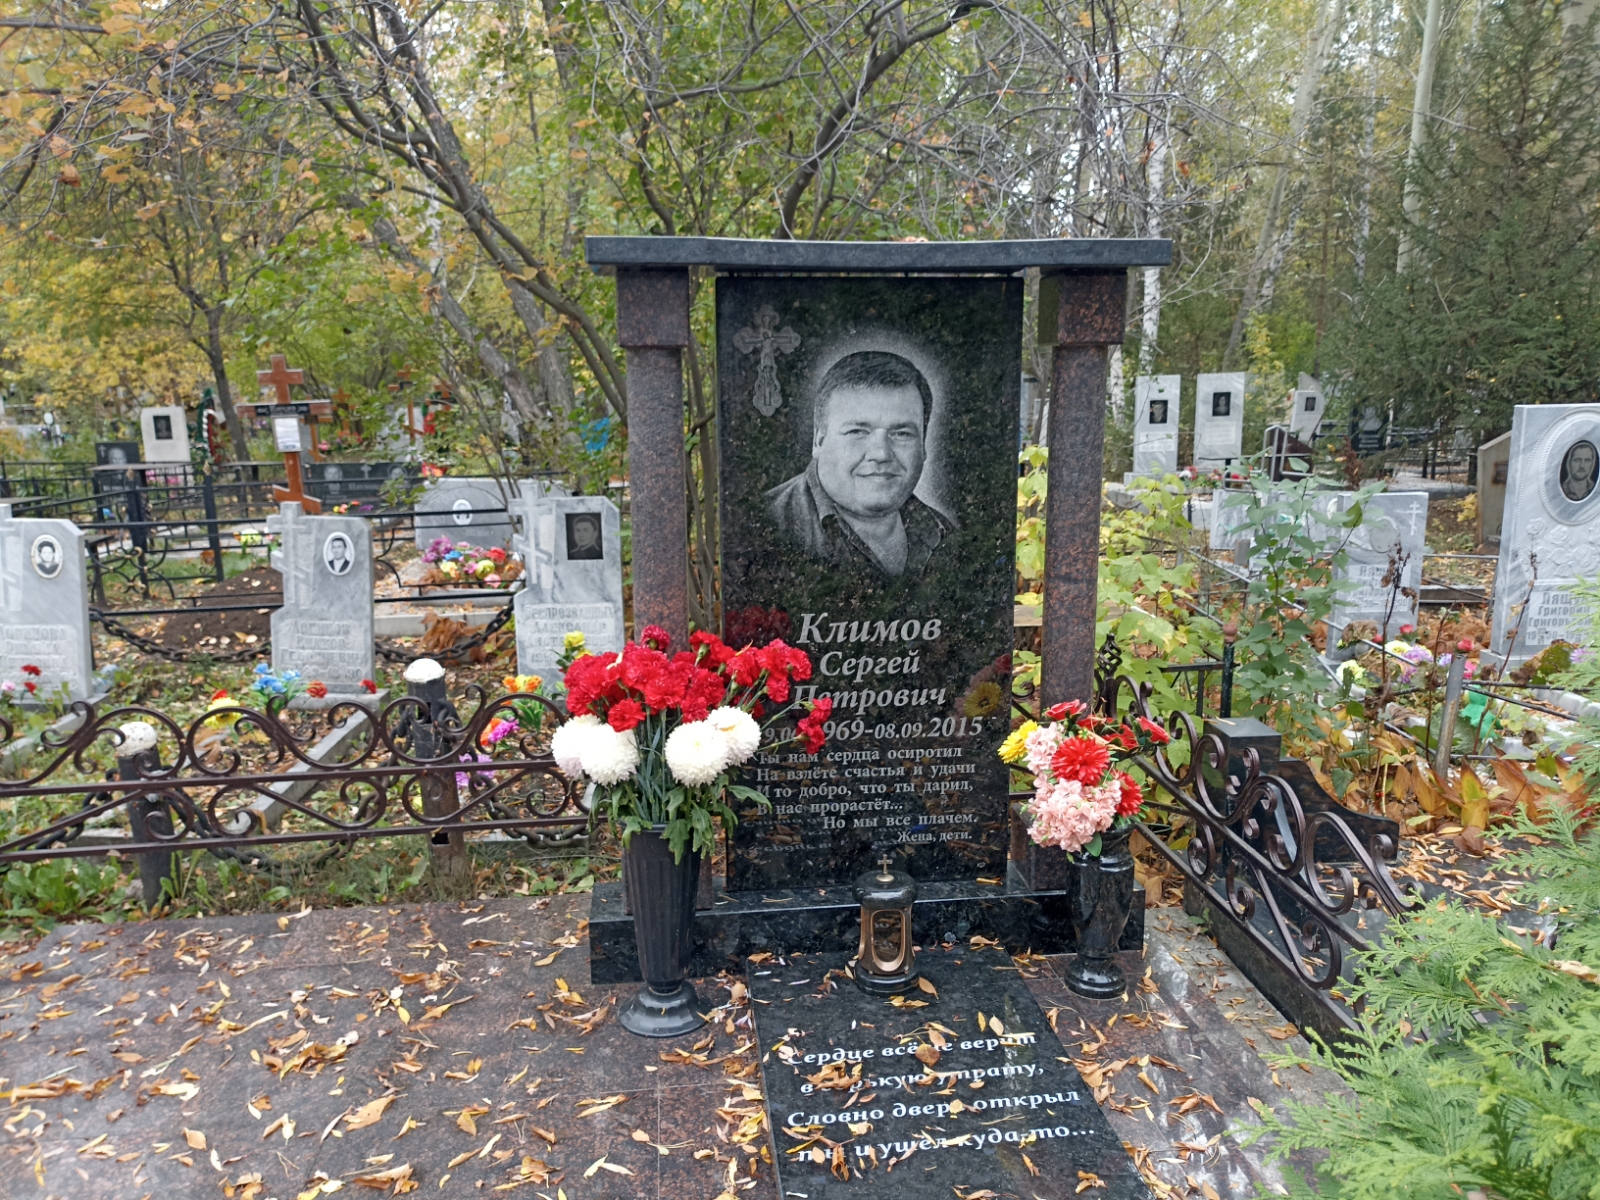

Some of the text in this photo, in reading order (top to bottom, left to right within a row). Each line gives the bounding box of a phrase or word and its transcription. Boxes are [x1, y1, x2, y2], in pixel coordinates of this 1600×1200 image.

[797, 613, 942, 643] Климов
[820, 650, 920, 682] Сергей
[757, 747, 962, 765] Ты нам сердца осиротил
[757, 763, 976, 781] На взлёте счастья и удачи
[774, 787, 792, 797] то
[799, 782, 852, 799] добро,
[859, 784, 887, 794] что
[894, 782, 915, 792] ты
[923, 779, 974, 795] дарил,
[776, 803, 803, 814] нас
[810, 797, 903, 816] прорастёт...
[823, 812, 978, 829] Но мы все плачем.
[897, 830, 973, 842] Жена, дети.
[787, 1048, 874, 1066] Сердце
[881, 1042, 919, 1057] всё
[800, 1083, 814, 1094] в
[820, 1073, 926, 1094] рькую
[787, 1091, 1080, 1127] Словно двер открыл
